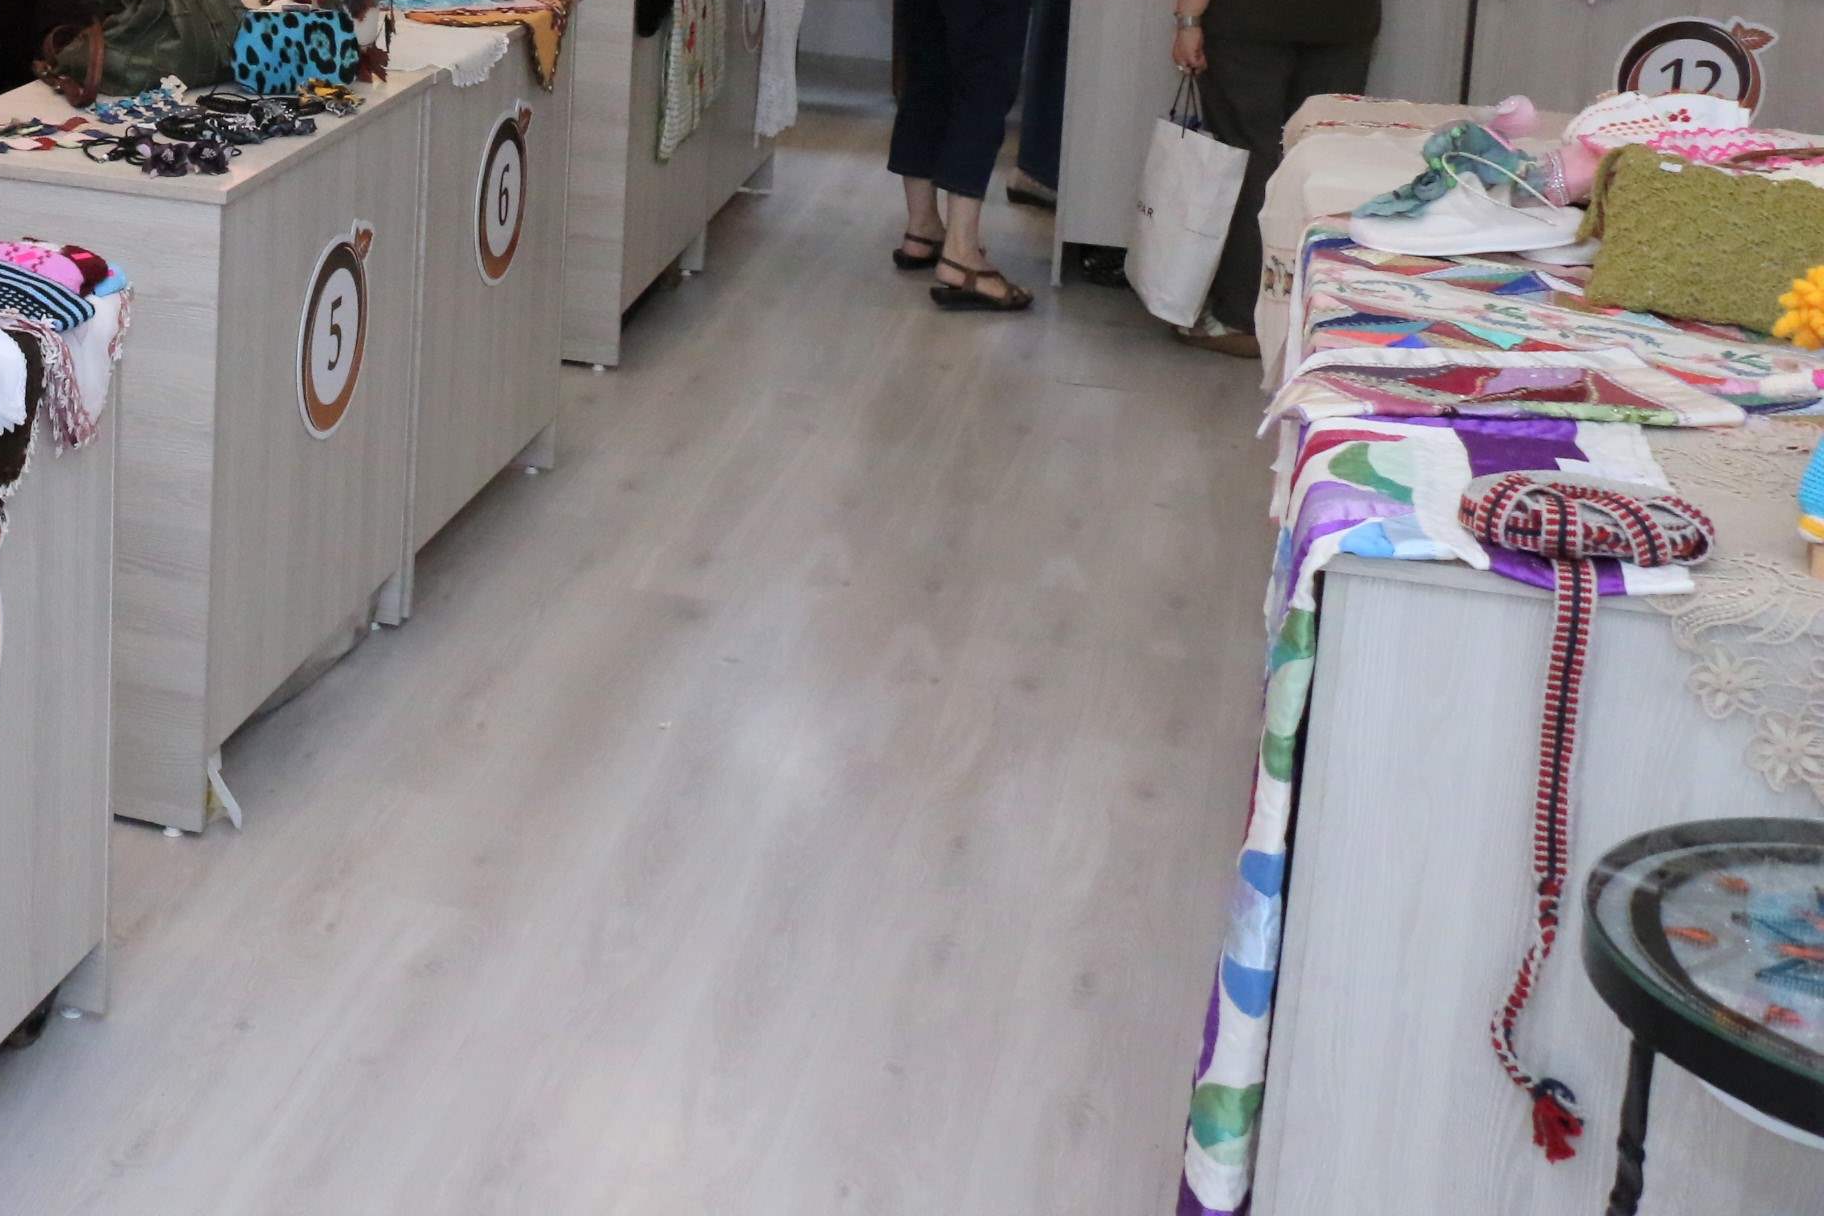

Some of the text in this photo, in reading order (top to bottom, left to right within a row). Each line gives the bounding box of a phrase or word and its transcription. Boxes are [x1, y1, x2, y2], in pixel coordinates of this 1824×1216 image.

[1660, 57, 1722, 95] 12
[498, 163, 511, 226] 6
[327, 295, 343, 372] 5
